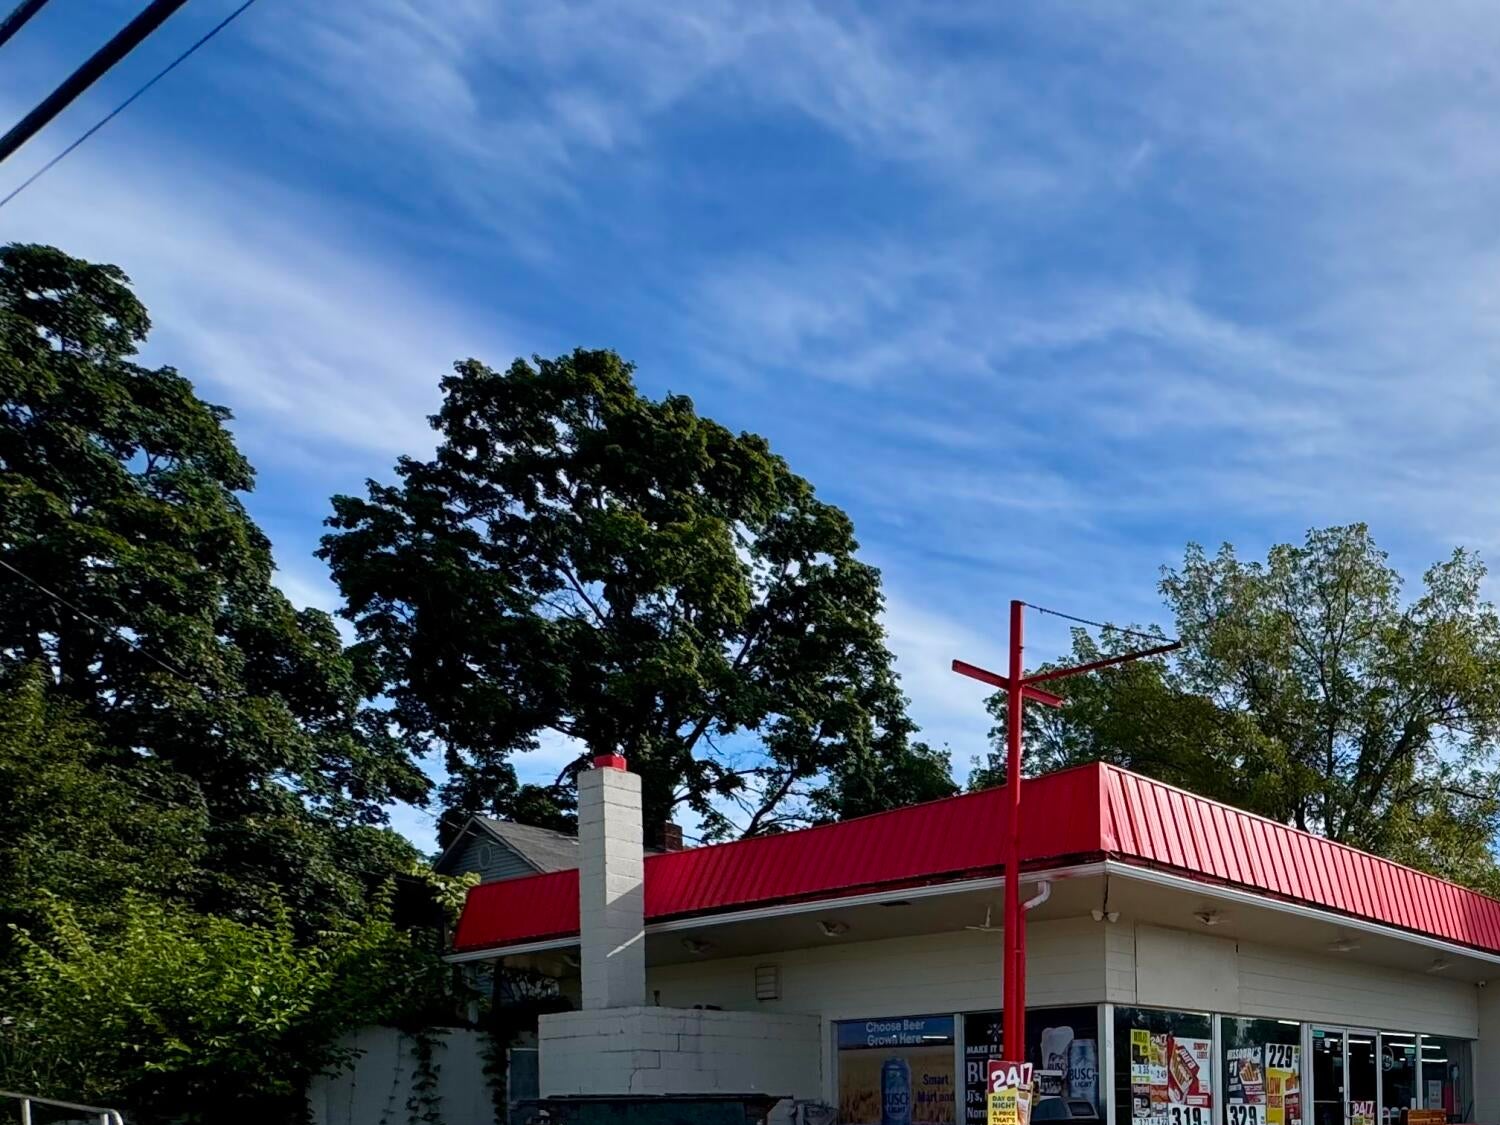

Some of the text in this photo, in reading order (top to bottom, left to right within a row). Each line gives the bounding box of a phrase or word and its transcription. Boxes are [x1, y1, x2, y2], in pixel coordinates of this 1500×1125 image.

[866, 1019, 925, 1033] Choose Beer
[867, 1034, 897, 1046] Grown
[1268, 1045, 1293, 1068] 229
[922, 1074, 949, 1085] Smart
